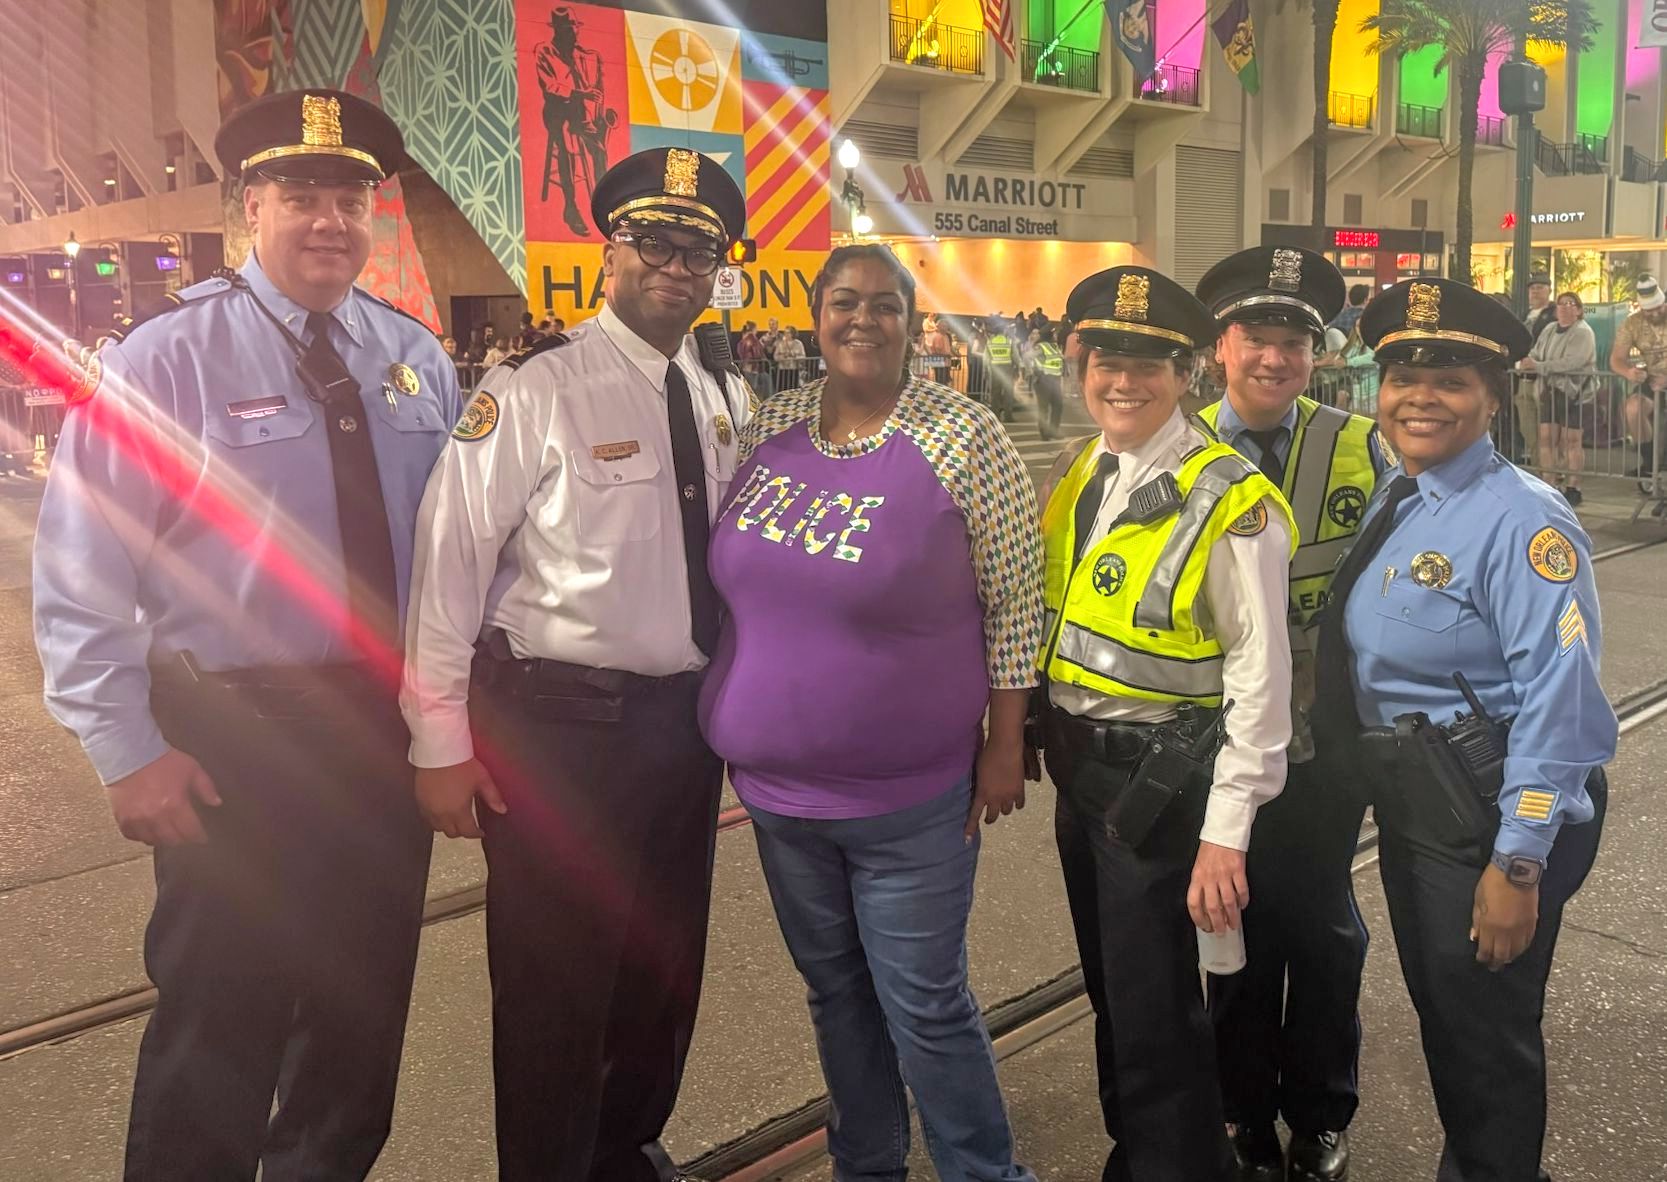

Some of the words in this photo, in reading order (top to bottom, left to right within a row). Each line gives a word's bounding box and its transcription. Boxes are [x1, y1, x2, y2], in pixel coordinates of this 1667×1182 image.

[946, 173, 1086, 209] MARRIOTT
[934, 212, 963, 231] 555
[967, 214, 1011, 234] Canal
[1015, 216, 1058, 236] Street
[1530, 211, 1585, 224] ARRIOTT
[719, 465, 885, 563] POLICE
